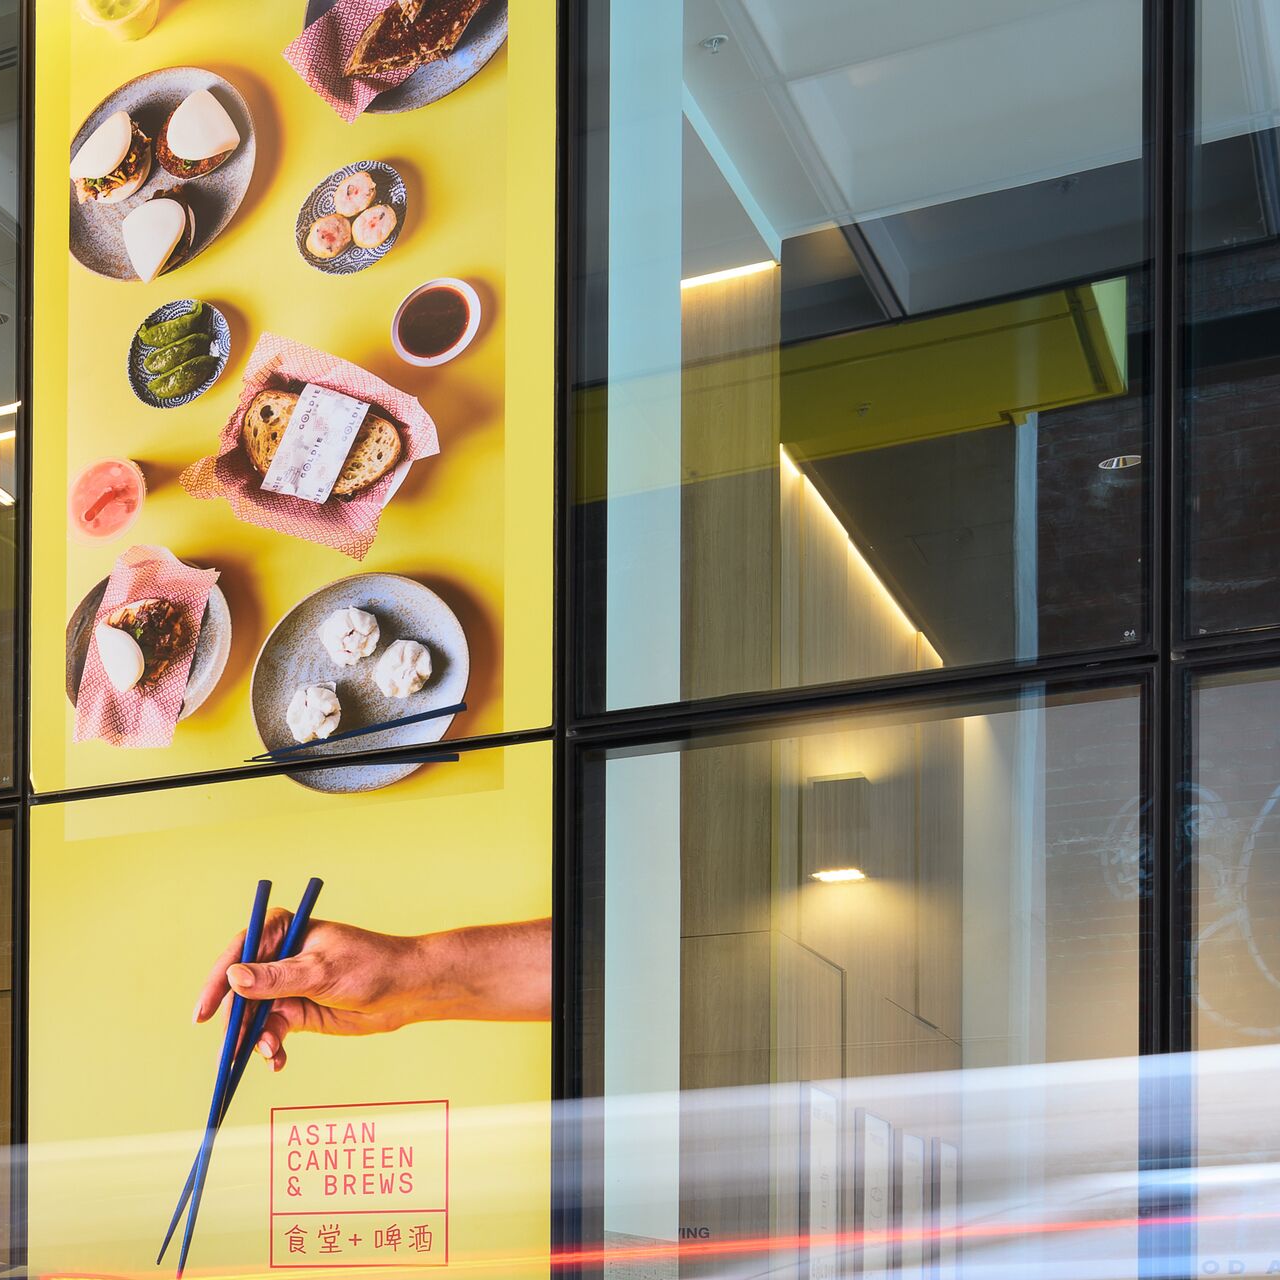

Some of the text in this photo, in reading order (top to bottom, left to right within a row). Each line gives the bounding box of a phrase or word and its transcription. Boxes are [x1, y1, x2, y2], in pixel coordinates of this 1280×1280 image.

[287, 1122, 376, 1147] ASIAN
[287, 1147, 415, 1171] CANTEEN
[287, 1173, 415, 1197] & BREWS
